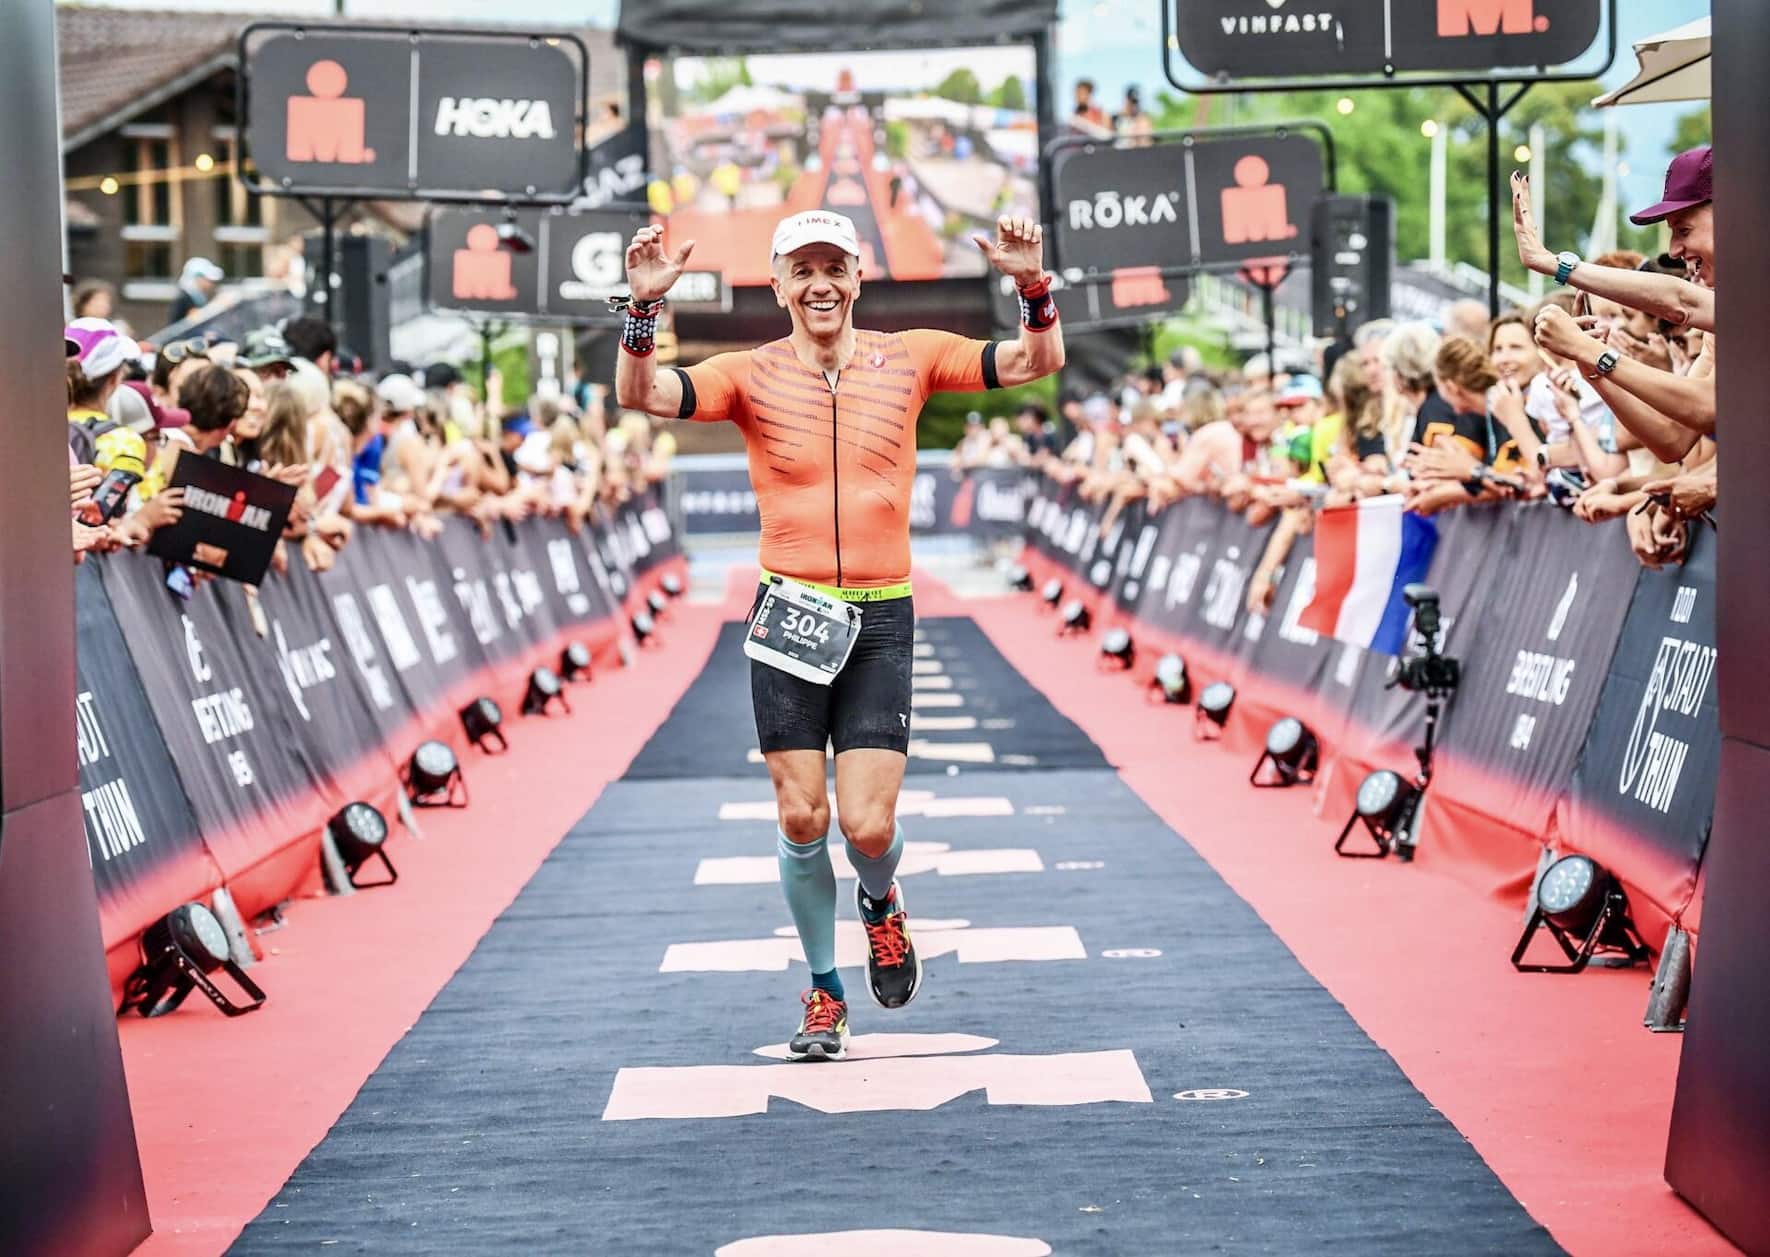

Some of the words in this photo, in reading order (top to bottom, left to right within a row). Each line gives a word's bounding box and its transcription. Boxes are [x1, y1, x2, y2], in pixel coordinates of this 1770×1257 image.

[1221, 13, 1333, 34] VINFAST
[434, 97, 554, 139] HOKA
[780, 607, 830, 643] 304
[783, 631, 818, 650] PHILIPPE
[1635, 731, 1689, 814] THUN
[82, 778, 145, 861] THUN
